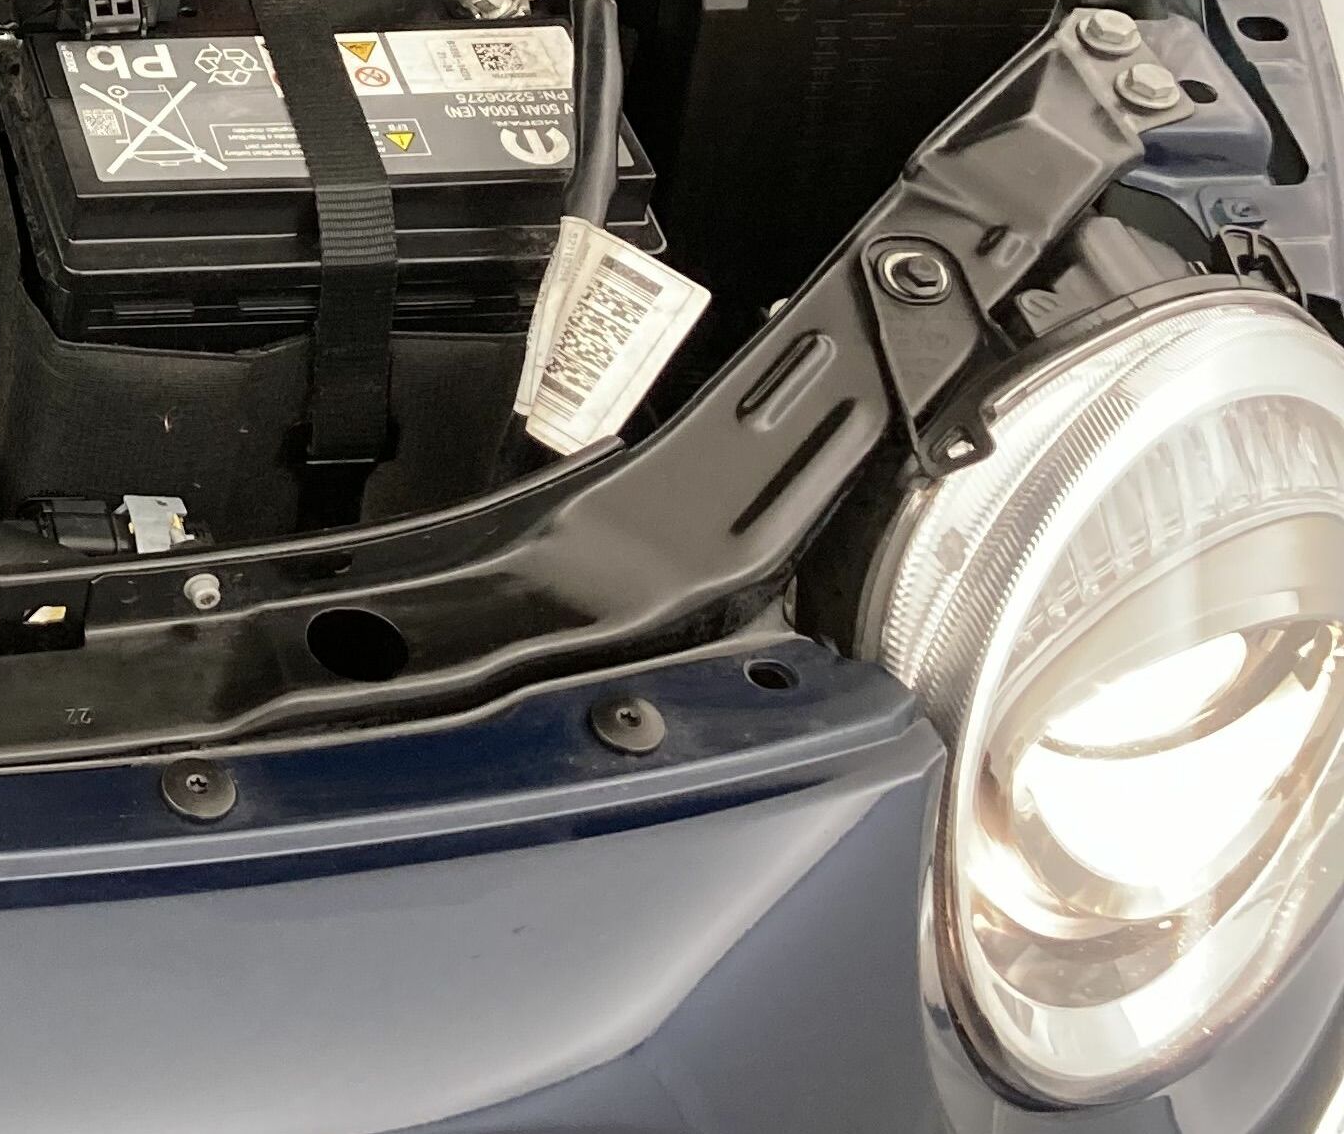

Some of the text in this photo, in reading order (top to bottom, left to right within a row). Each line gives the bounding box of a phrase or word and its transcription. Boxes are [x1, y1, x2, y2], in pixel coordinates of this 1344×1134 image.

[86, 43, 179, 79] Pb
[455, 90, 569, 104] PN: 52206275
[444, 104, 476, 118] (EN)
[478, 105, 519, 117] 500A
[521, 103, 561, 116] 50Ah
